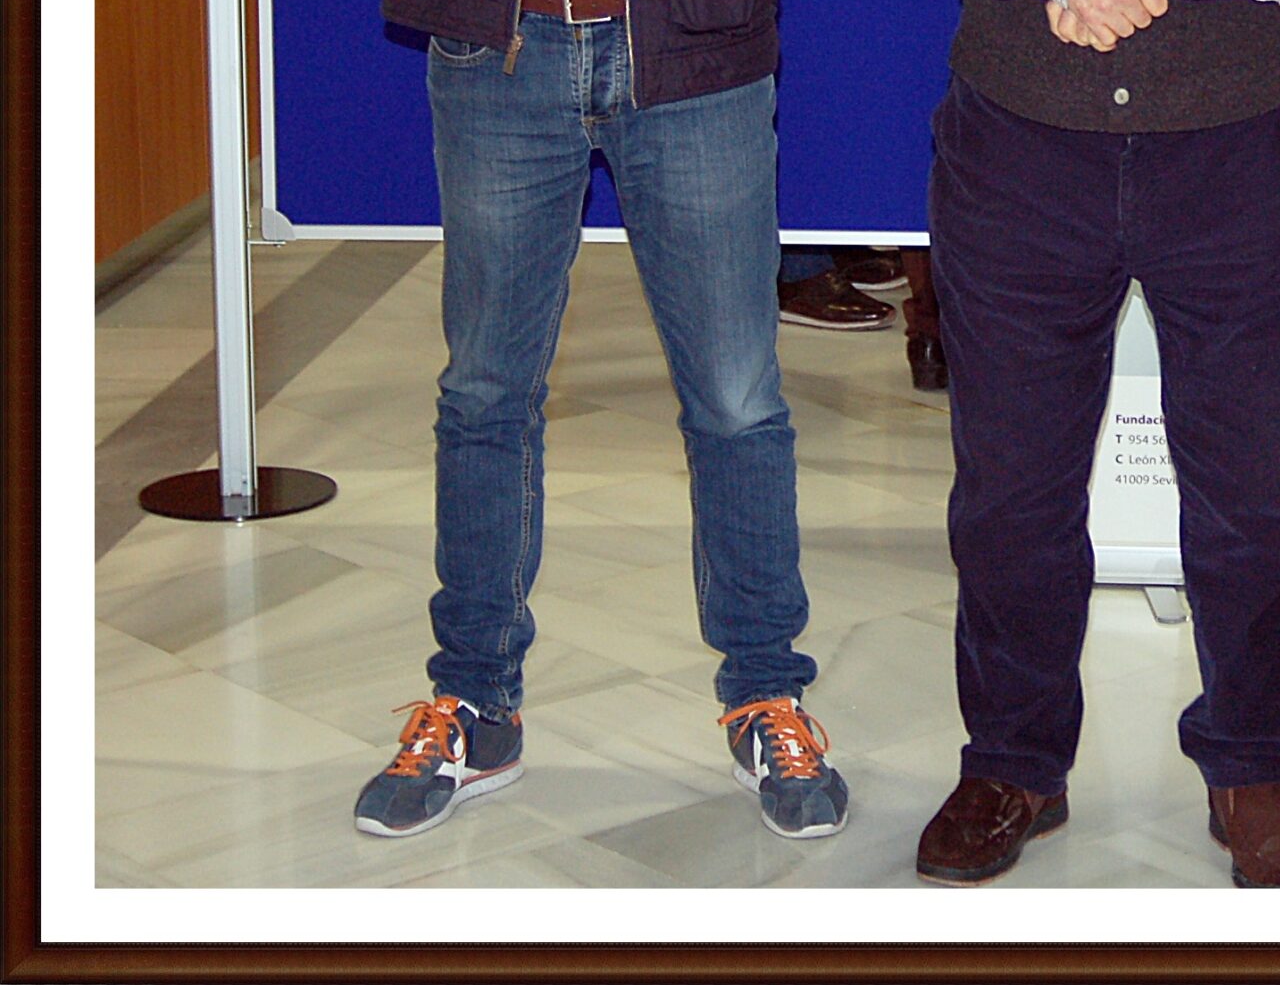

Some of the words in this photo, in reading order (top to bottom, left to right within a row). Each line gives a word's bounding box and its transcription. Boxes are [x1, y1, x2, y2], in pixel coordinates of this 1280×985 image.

[1115, 414, 1165, 425] Fundaci
[1115, 434, 1123, 444] T
[1128, 435, 1149, 445] 954
[1115, 454, 1123, 464] C
[1129, 455, 1157, 465] León
[1115, 475, 1150, 485] 41009
[1152, 475, 1177, 485] Sevi
